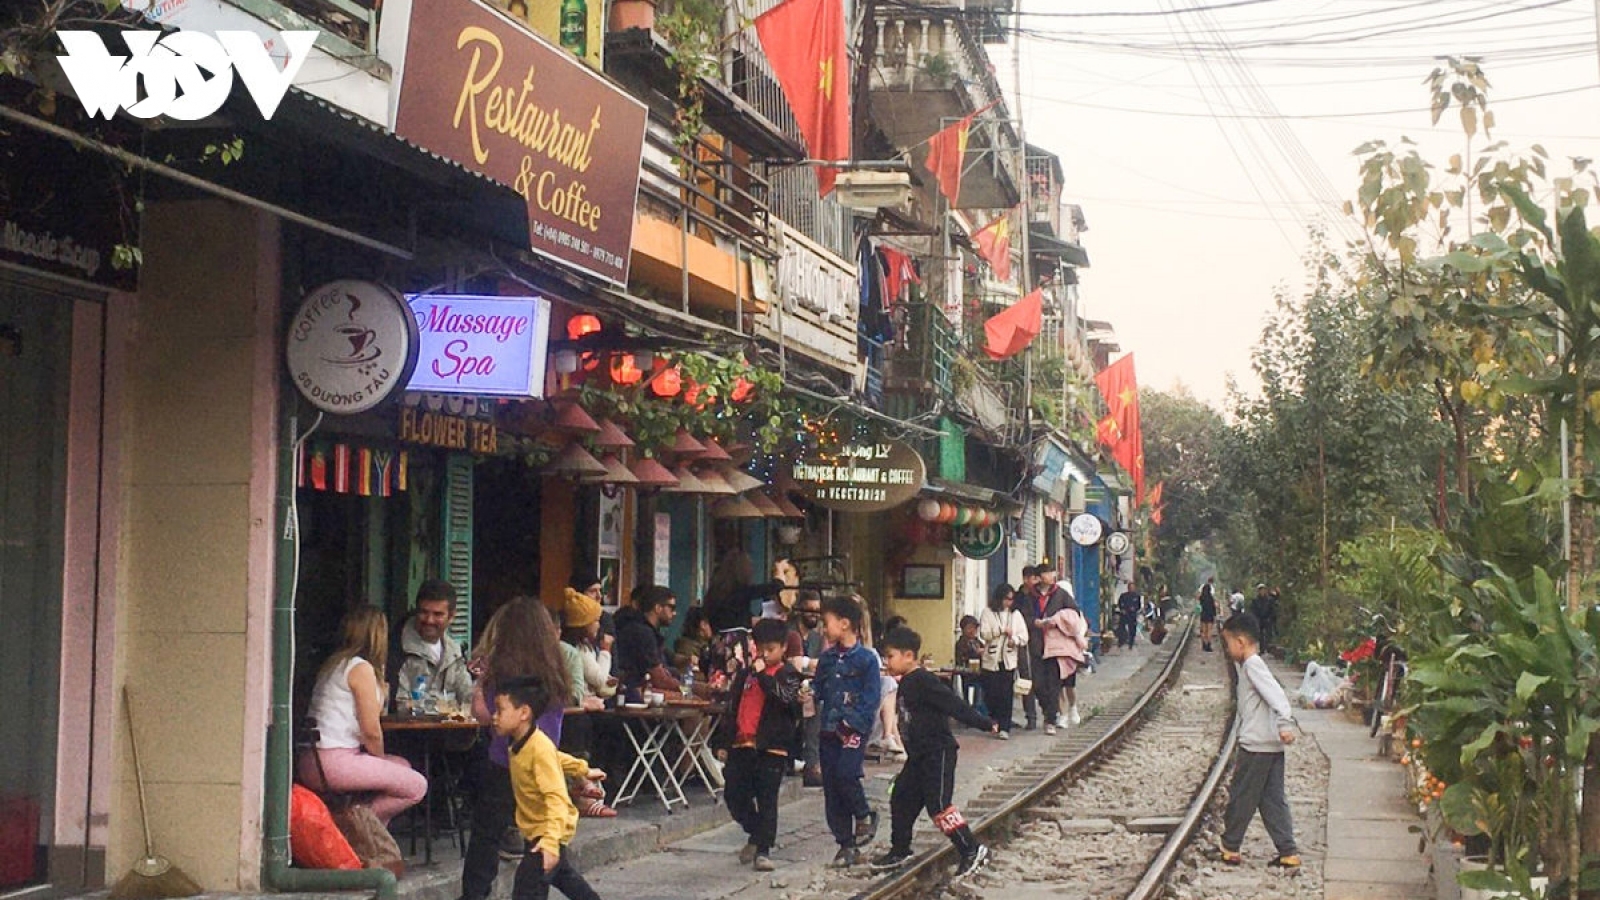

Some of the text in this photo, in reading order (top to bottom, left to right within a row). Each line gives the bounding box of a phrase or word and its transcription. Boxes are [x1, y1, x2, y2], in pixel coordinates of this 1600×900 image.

[453, 26, 601, 173] Restaurant
[514, 155, 601, 231] & Coffee
[415, 305, 528, 342] Massage
[431, 339, 497, 384] Spa
[401, 408, 498, 453] FLOWER TEA
[835, 467, 880, 483] RESAURANT
[888, 468, 914, 485] COFFEE
